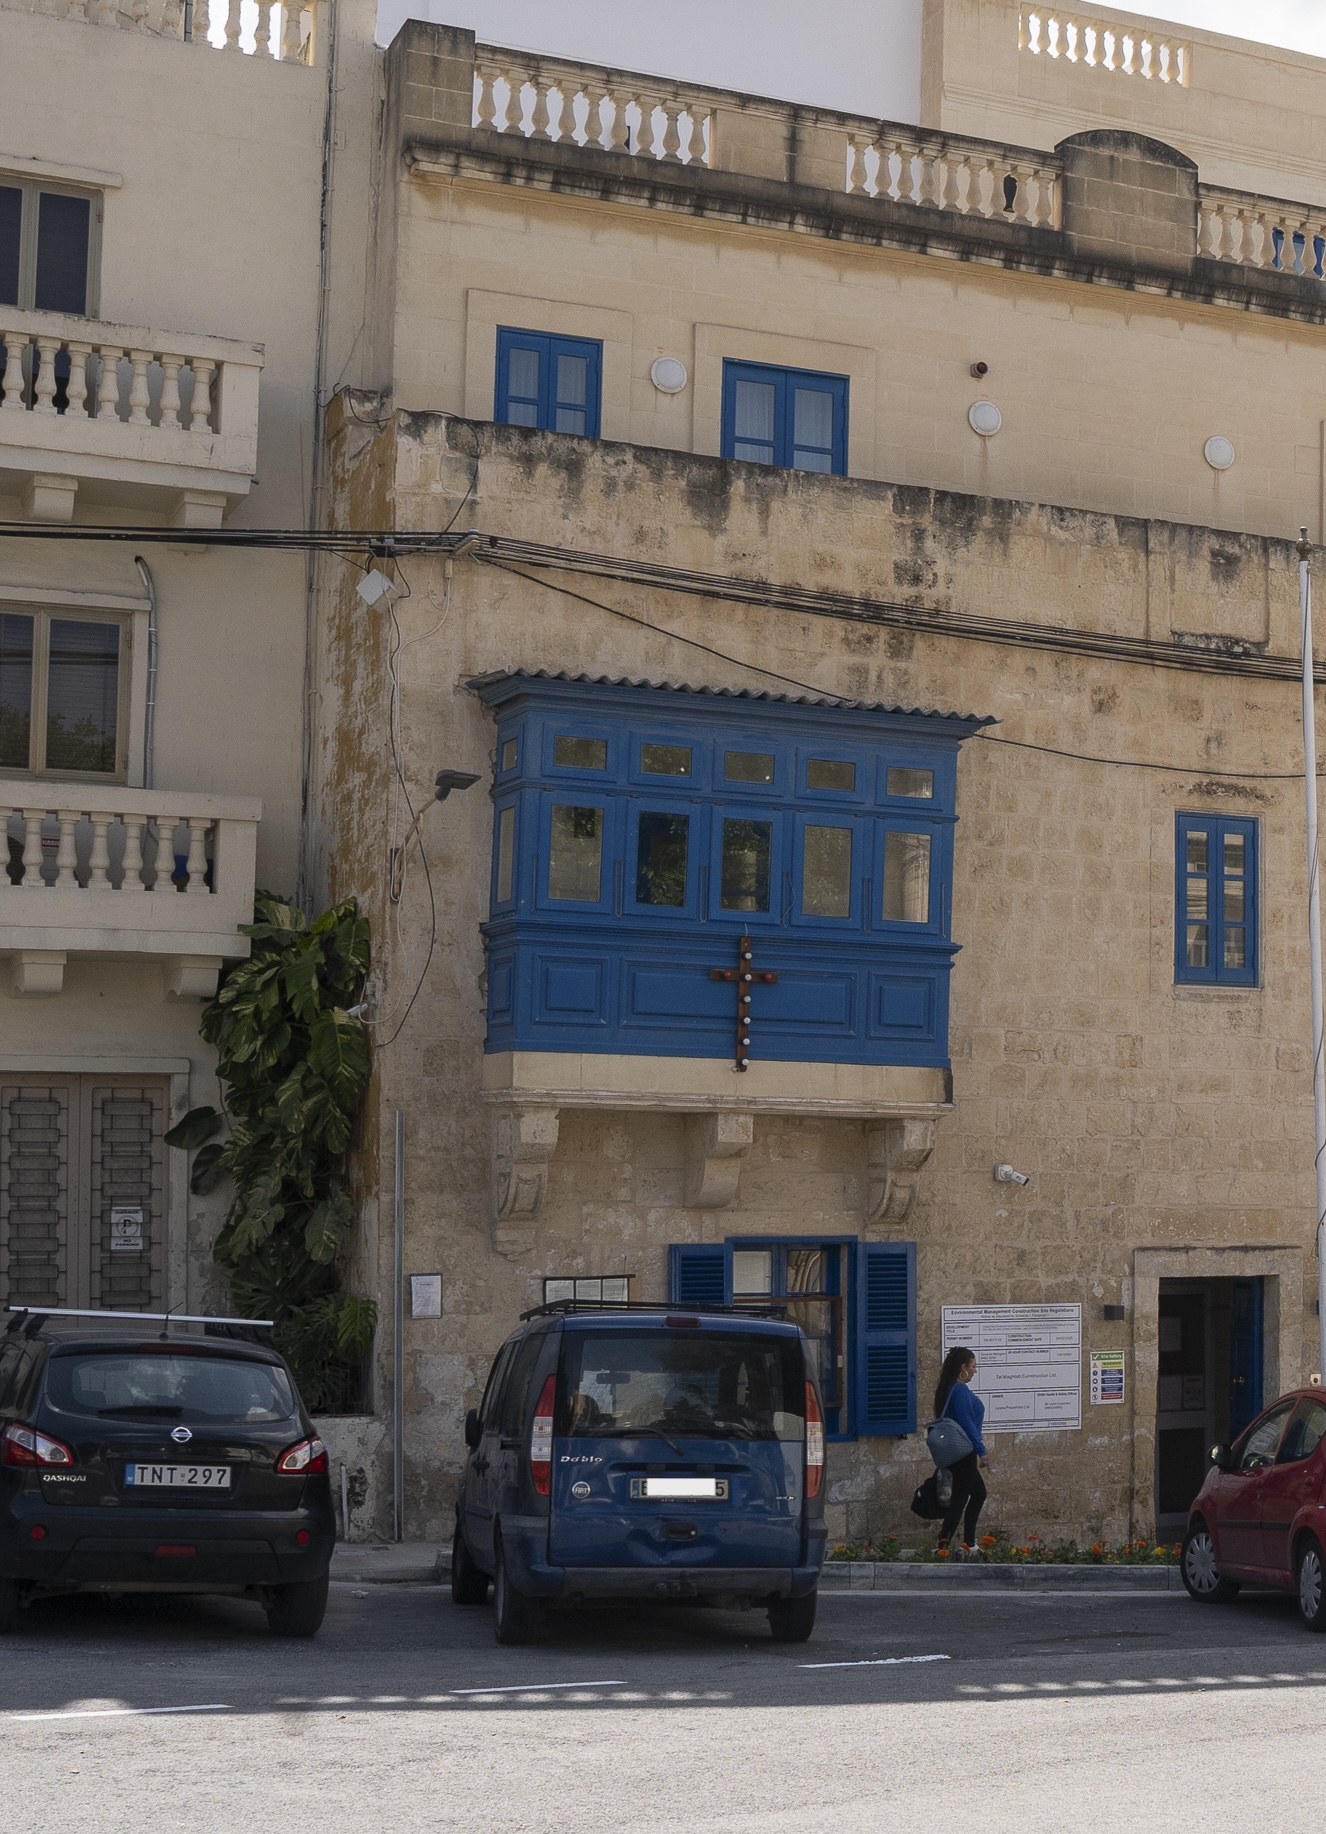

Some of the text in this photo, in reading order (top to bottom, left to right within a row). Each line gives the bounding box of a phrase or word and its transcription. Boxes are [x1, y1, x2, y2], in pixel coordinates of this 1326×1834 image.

[43, 1474, 87, 1482] QASHQAI
[137, 1466, 227, 1485] TNT 297
